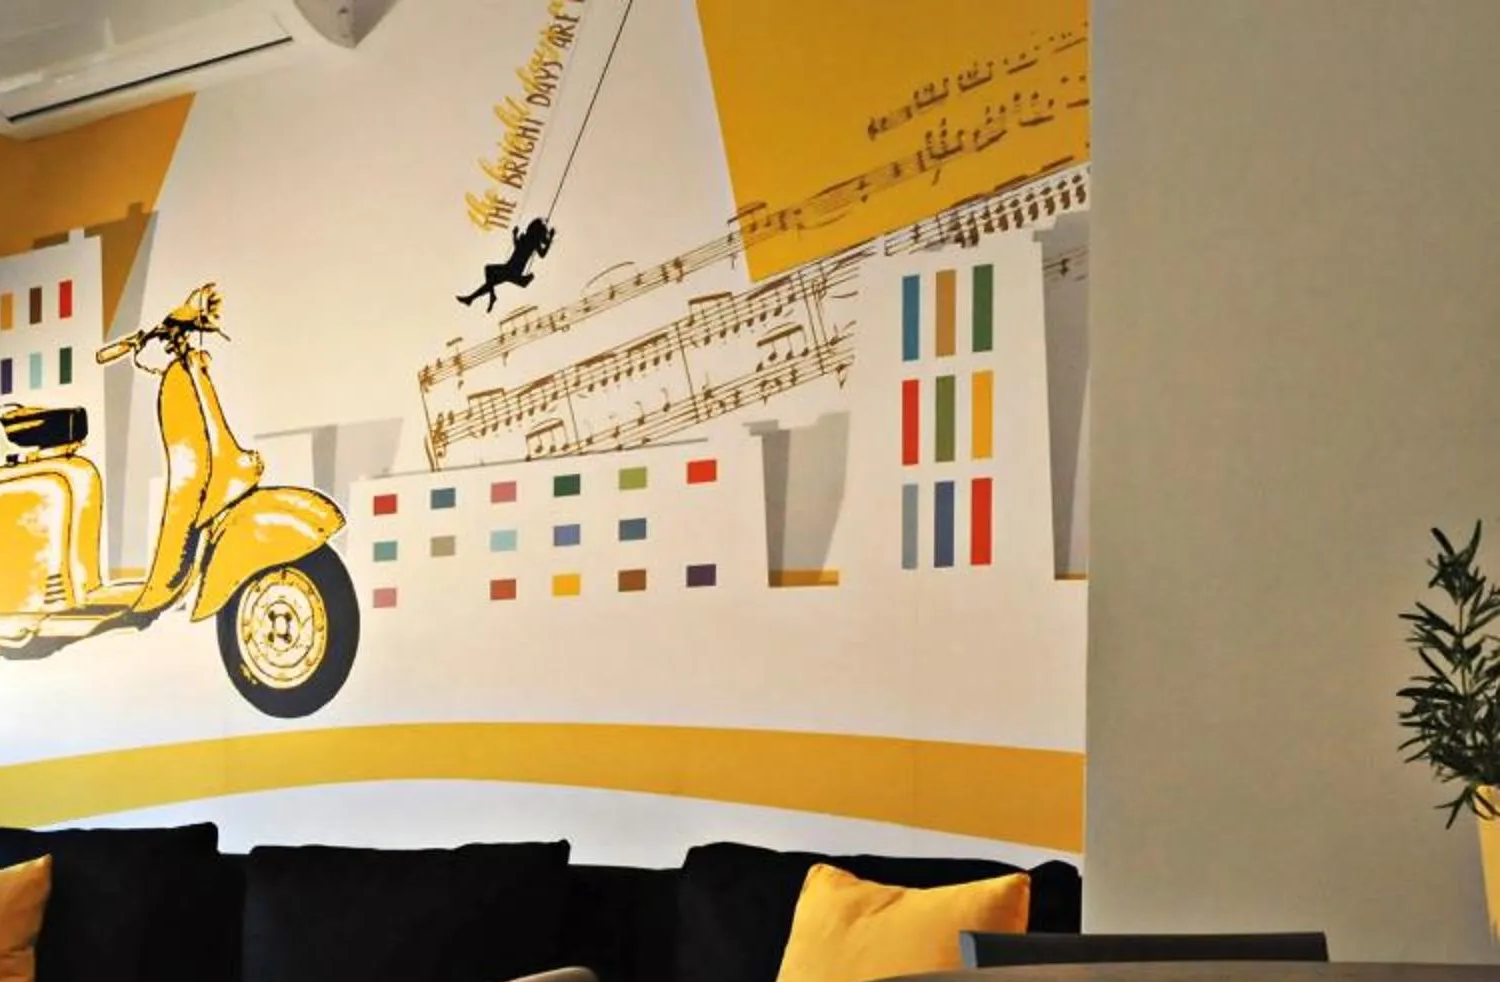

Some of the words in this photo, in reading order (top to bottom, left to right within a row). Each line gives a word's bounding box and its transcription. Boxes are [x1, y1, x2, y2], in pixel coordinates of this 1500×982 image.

[484, 198, 517, 229] THE
[501, 118, 545, 189] BRIGHT
[526, 60, 564, 108] DAYS
[549, 14, 581, 49] ARE
